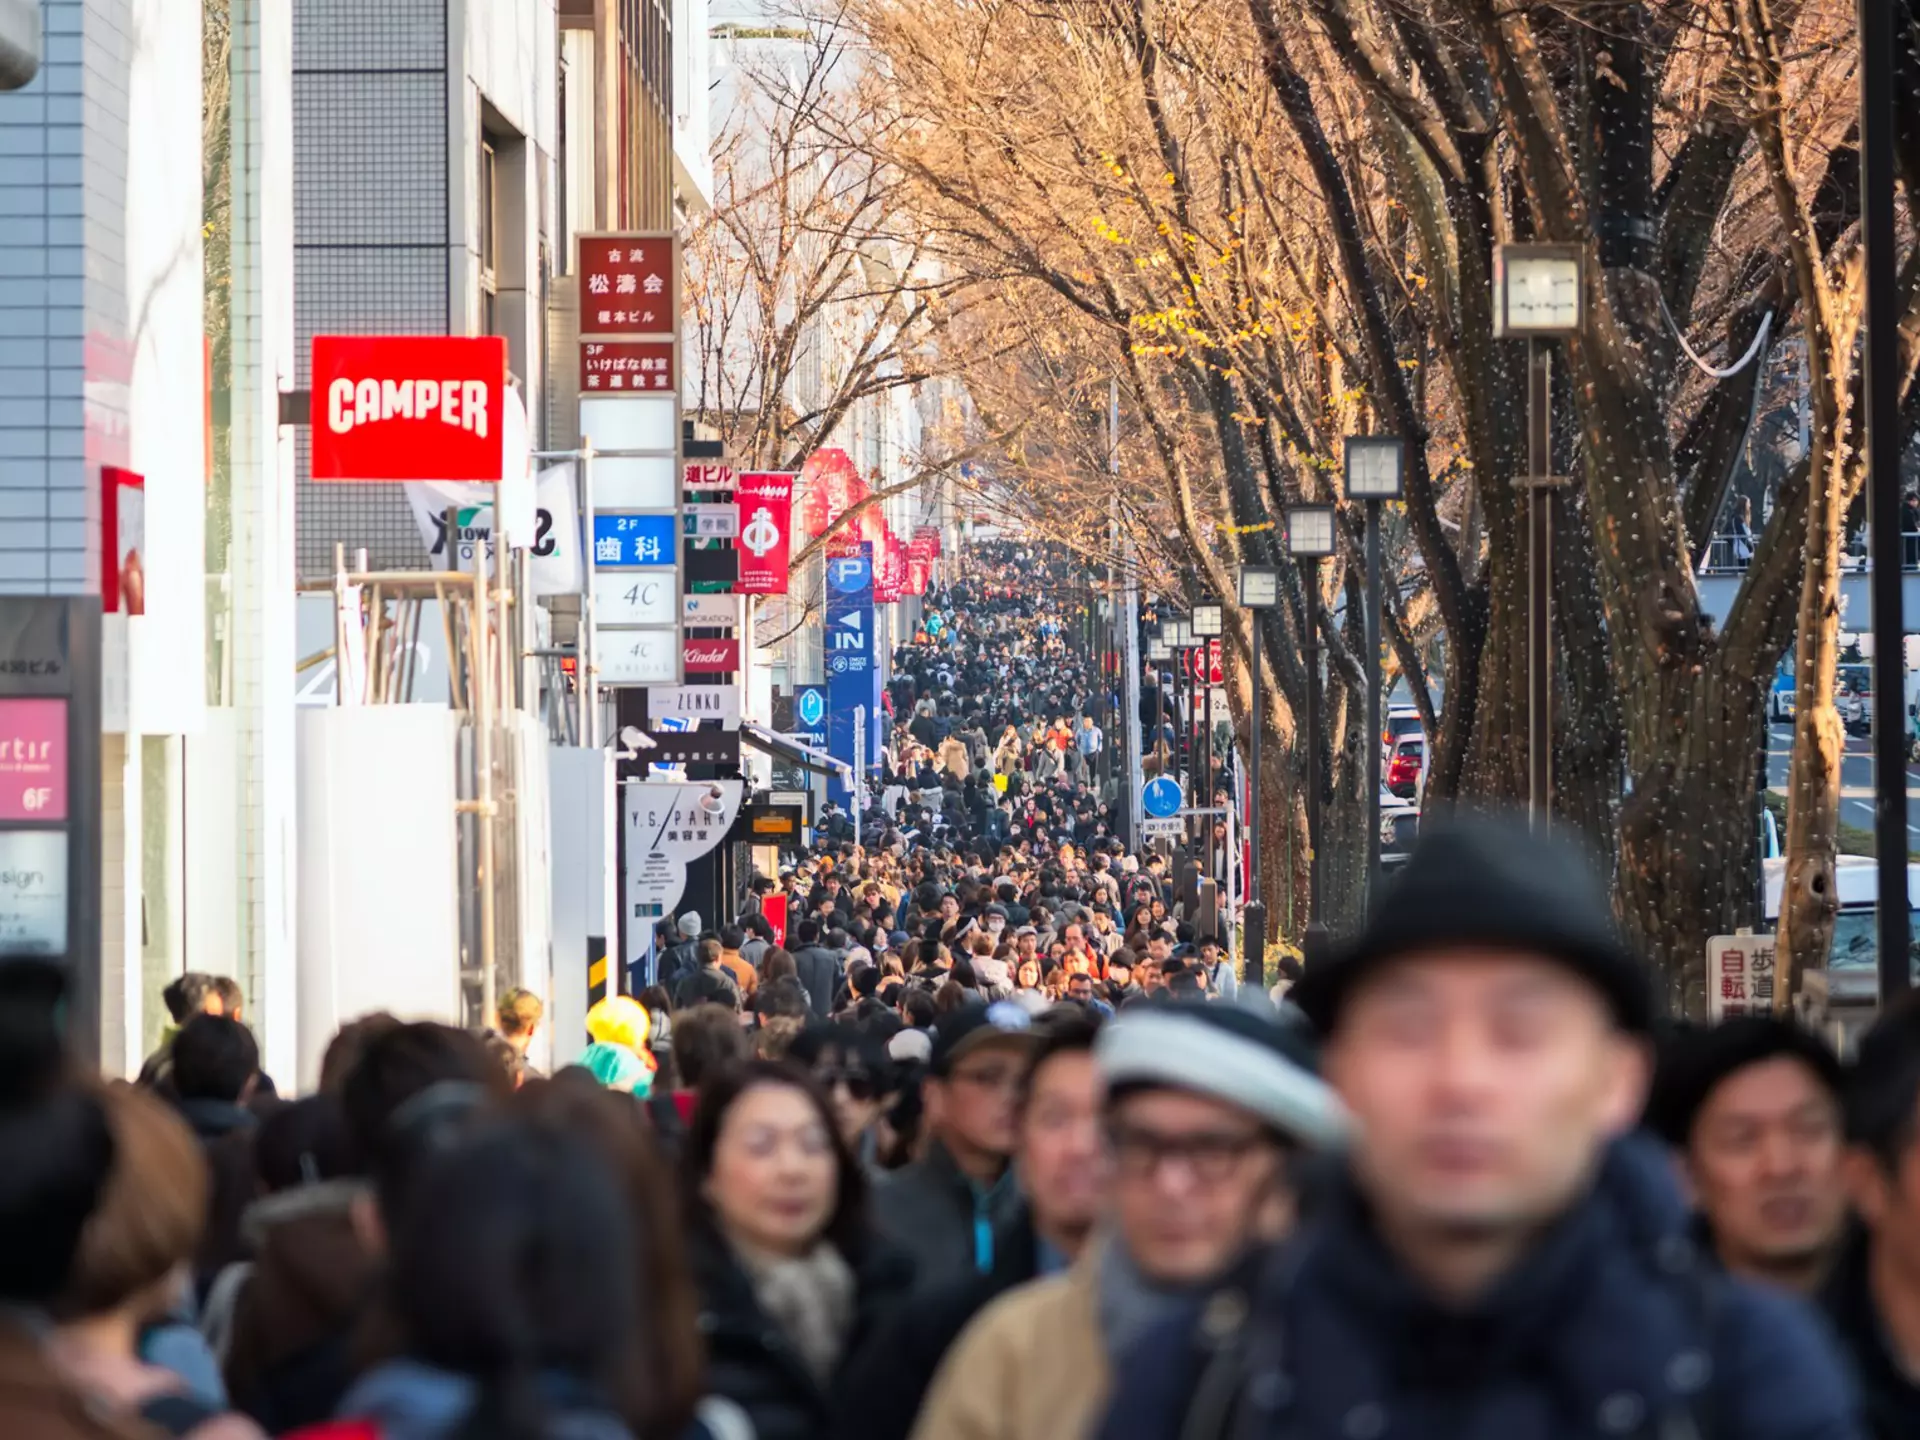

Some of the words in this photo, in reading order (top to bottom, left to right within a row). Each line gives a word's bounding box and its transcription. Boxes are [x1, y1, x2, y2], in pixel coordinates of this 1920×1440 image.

[608, 249, 644, 263] 古流
[586, 345, 604, 355] 3F
[586, 358, 667, 371] いけばな教室
[328, 377, 488, 438] CAMPER
[617, 518, 638, 530] 2F
[595, 536, 661, 561] 歯科
[839, 560, 862, 583] P
[623, 582, 659, 605] 4C
[835, 632, 864, 649] IN
[678, 693, 720, 710] ZENKO
[23, 788, 51, 811] 6F
